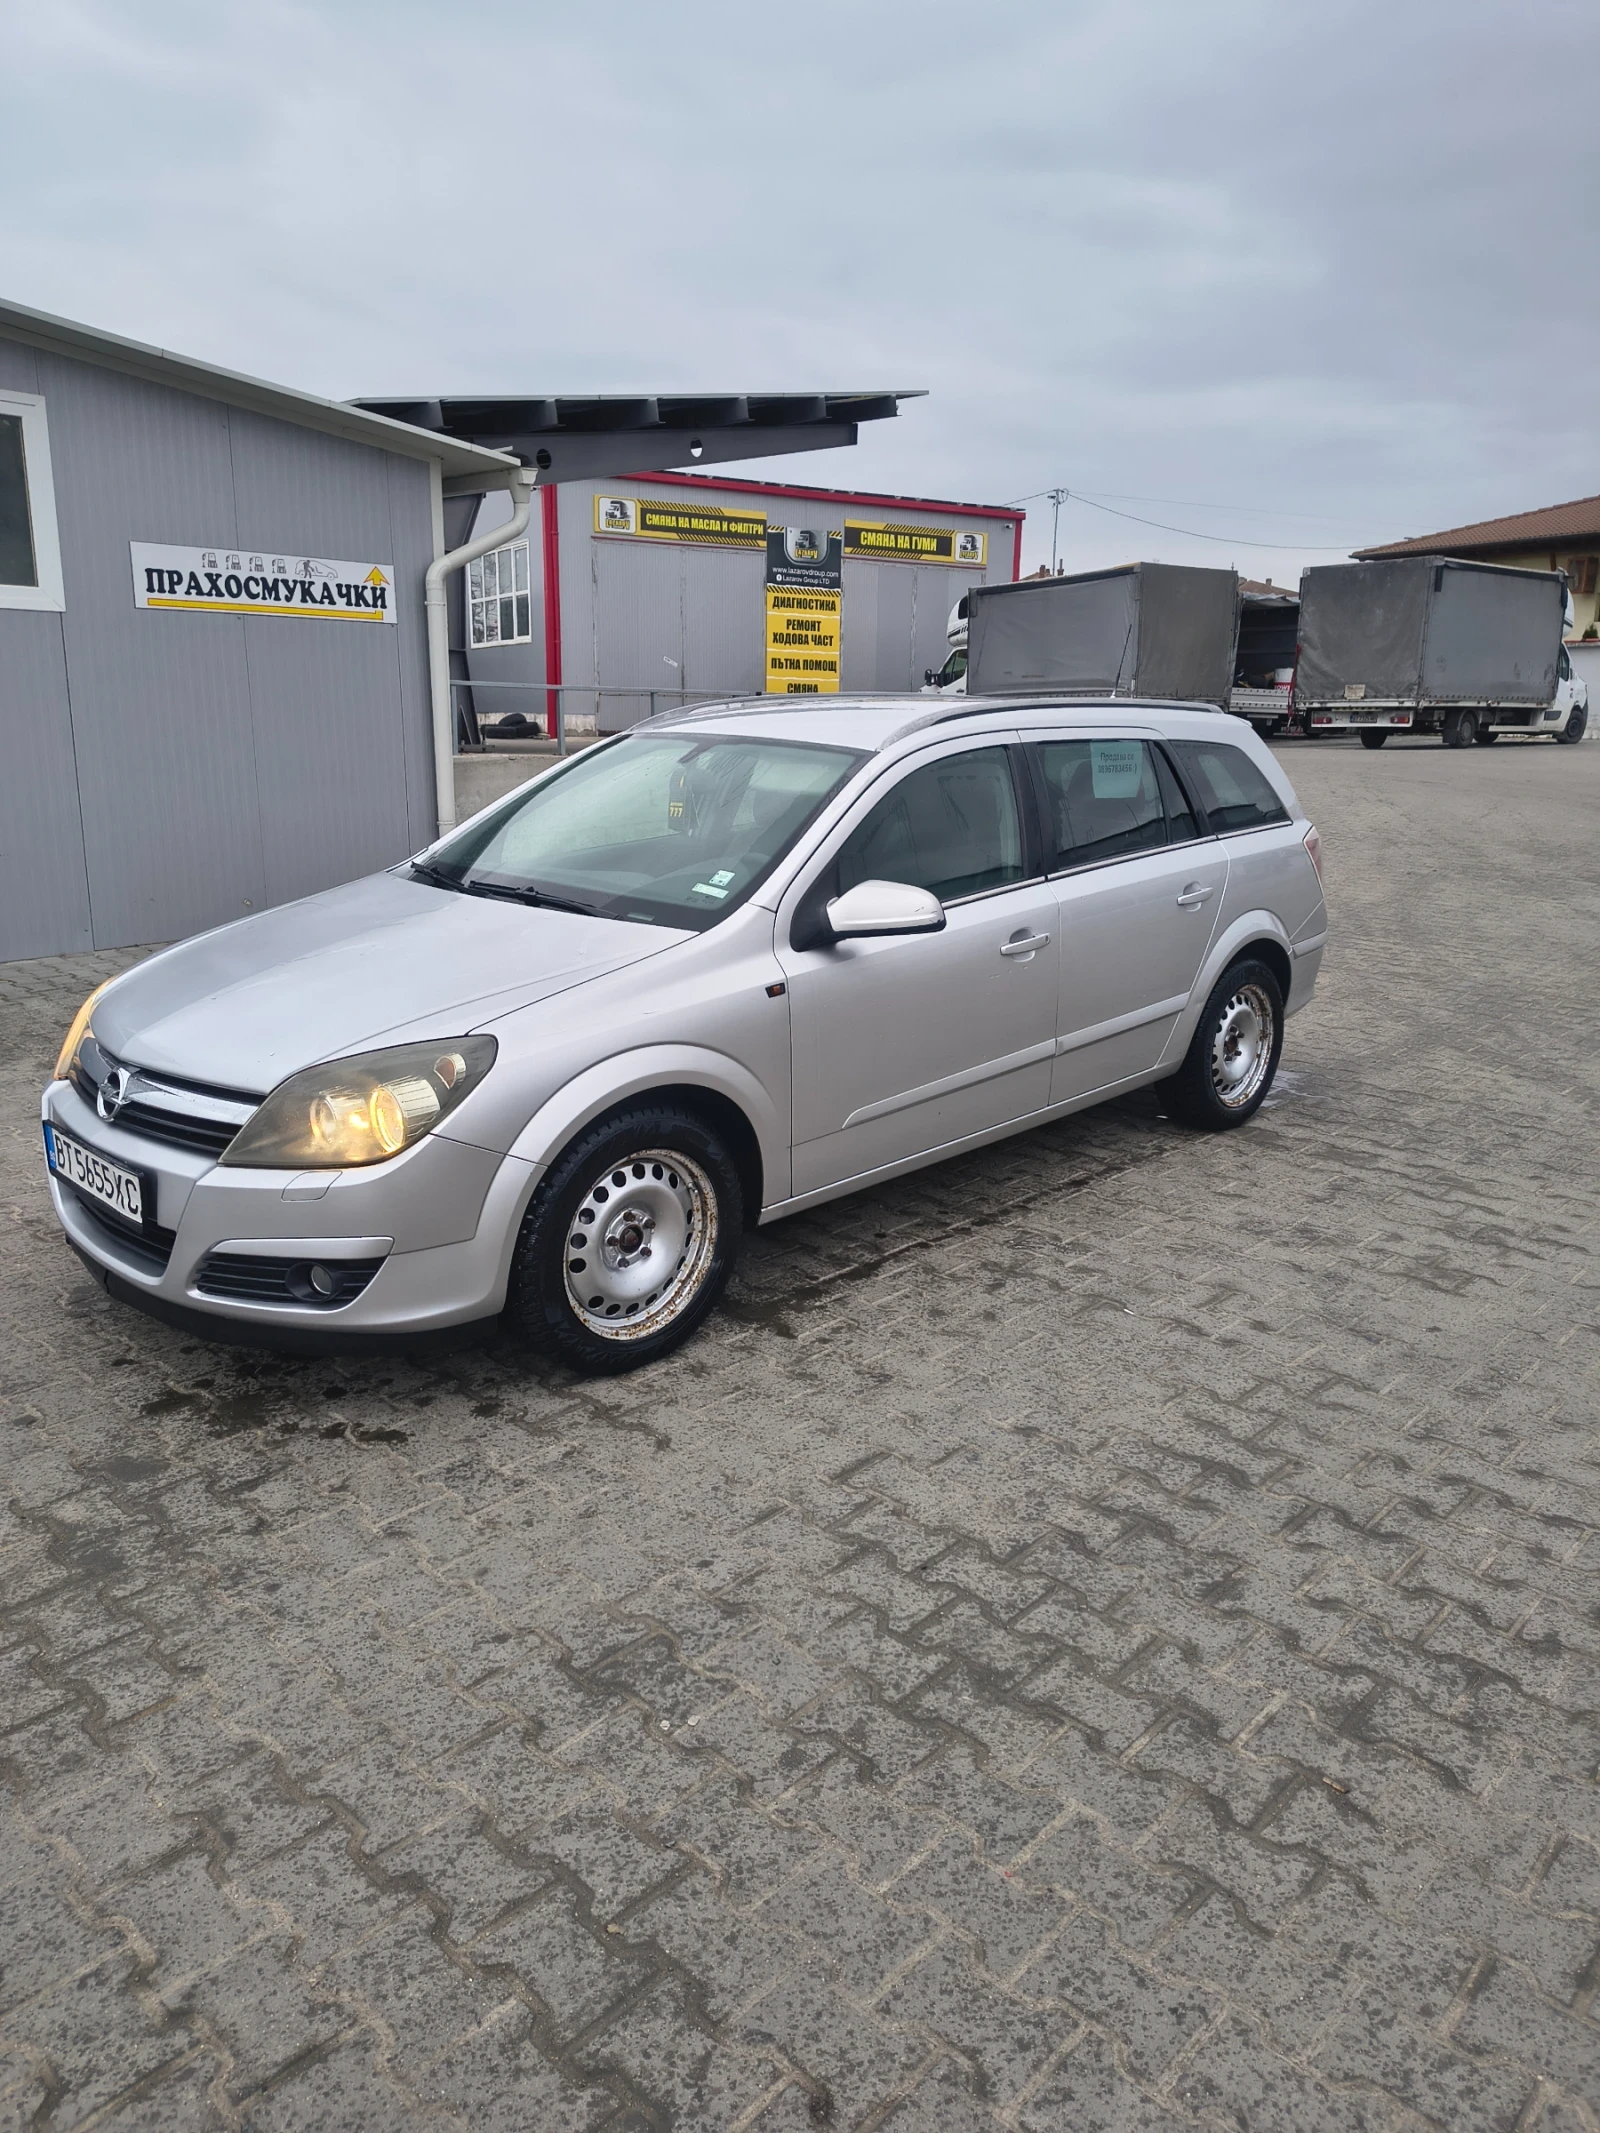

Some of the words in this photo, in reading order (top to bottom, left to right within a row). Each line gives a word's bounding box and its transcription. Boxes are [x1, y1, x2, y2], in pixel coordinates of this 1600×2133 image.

[646, 513, 676, 528] СМЯНА
[678, 516, 690, 528] НА
[691, 518, 721, 531] МАСЛА
[722, 521, 728, 532] И
[729, 522, 764, 535] ФИЛТРИ
[860, 531, 896, 548] СМЯНА
[897, 535, 910, 549] НА
[911, 536, 937, 551] ГУМИ
[144, 568, 388, 609] ПРАХОСМУКАЧКИ
[772, 596, 837, 612] ДИАГНОСТИКА
[786, 619, 822, 632] РЕМОНТ
[772, 632, 810, 646] ХОДОВА
[811, 635, 834, 647] ЧАСТ
[771, 657, 802, 671] ПЪТНА
[803, 659, 837, 673] ПОМОЩ
[787, 683, 819, 693] СМЯНА
